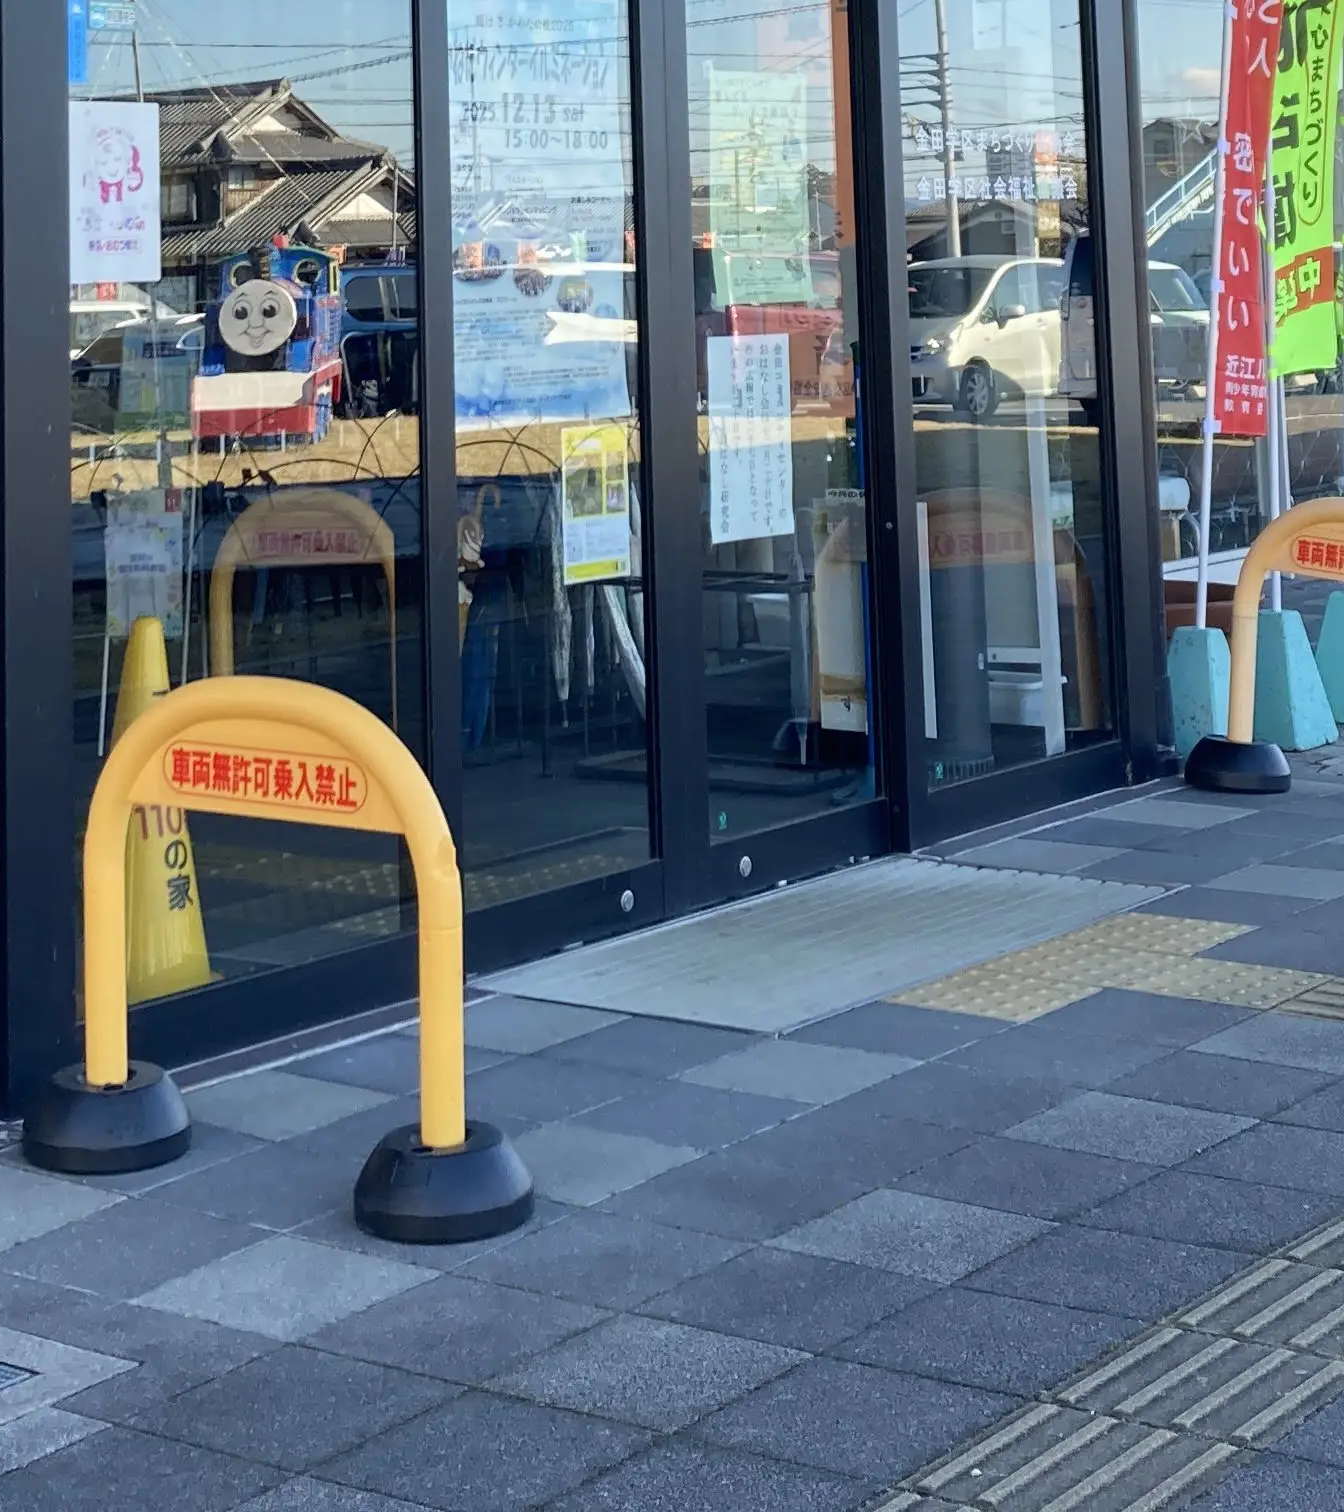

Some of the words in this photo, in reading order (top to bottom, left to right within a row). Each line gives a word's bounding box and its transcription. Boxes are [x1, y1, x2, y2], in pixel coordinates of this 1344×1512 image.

[915, 124, 1077, 154] 金田学区まちづくり会
[170, 746, 358, 809] 車両無許可乗入禁止
